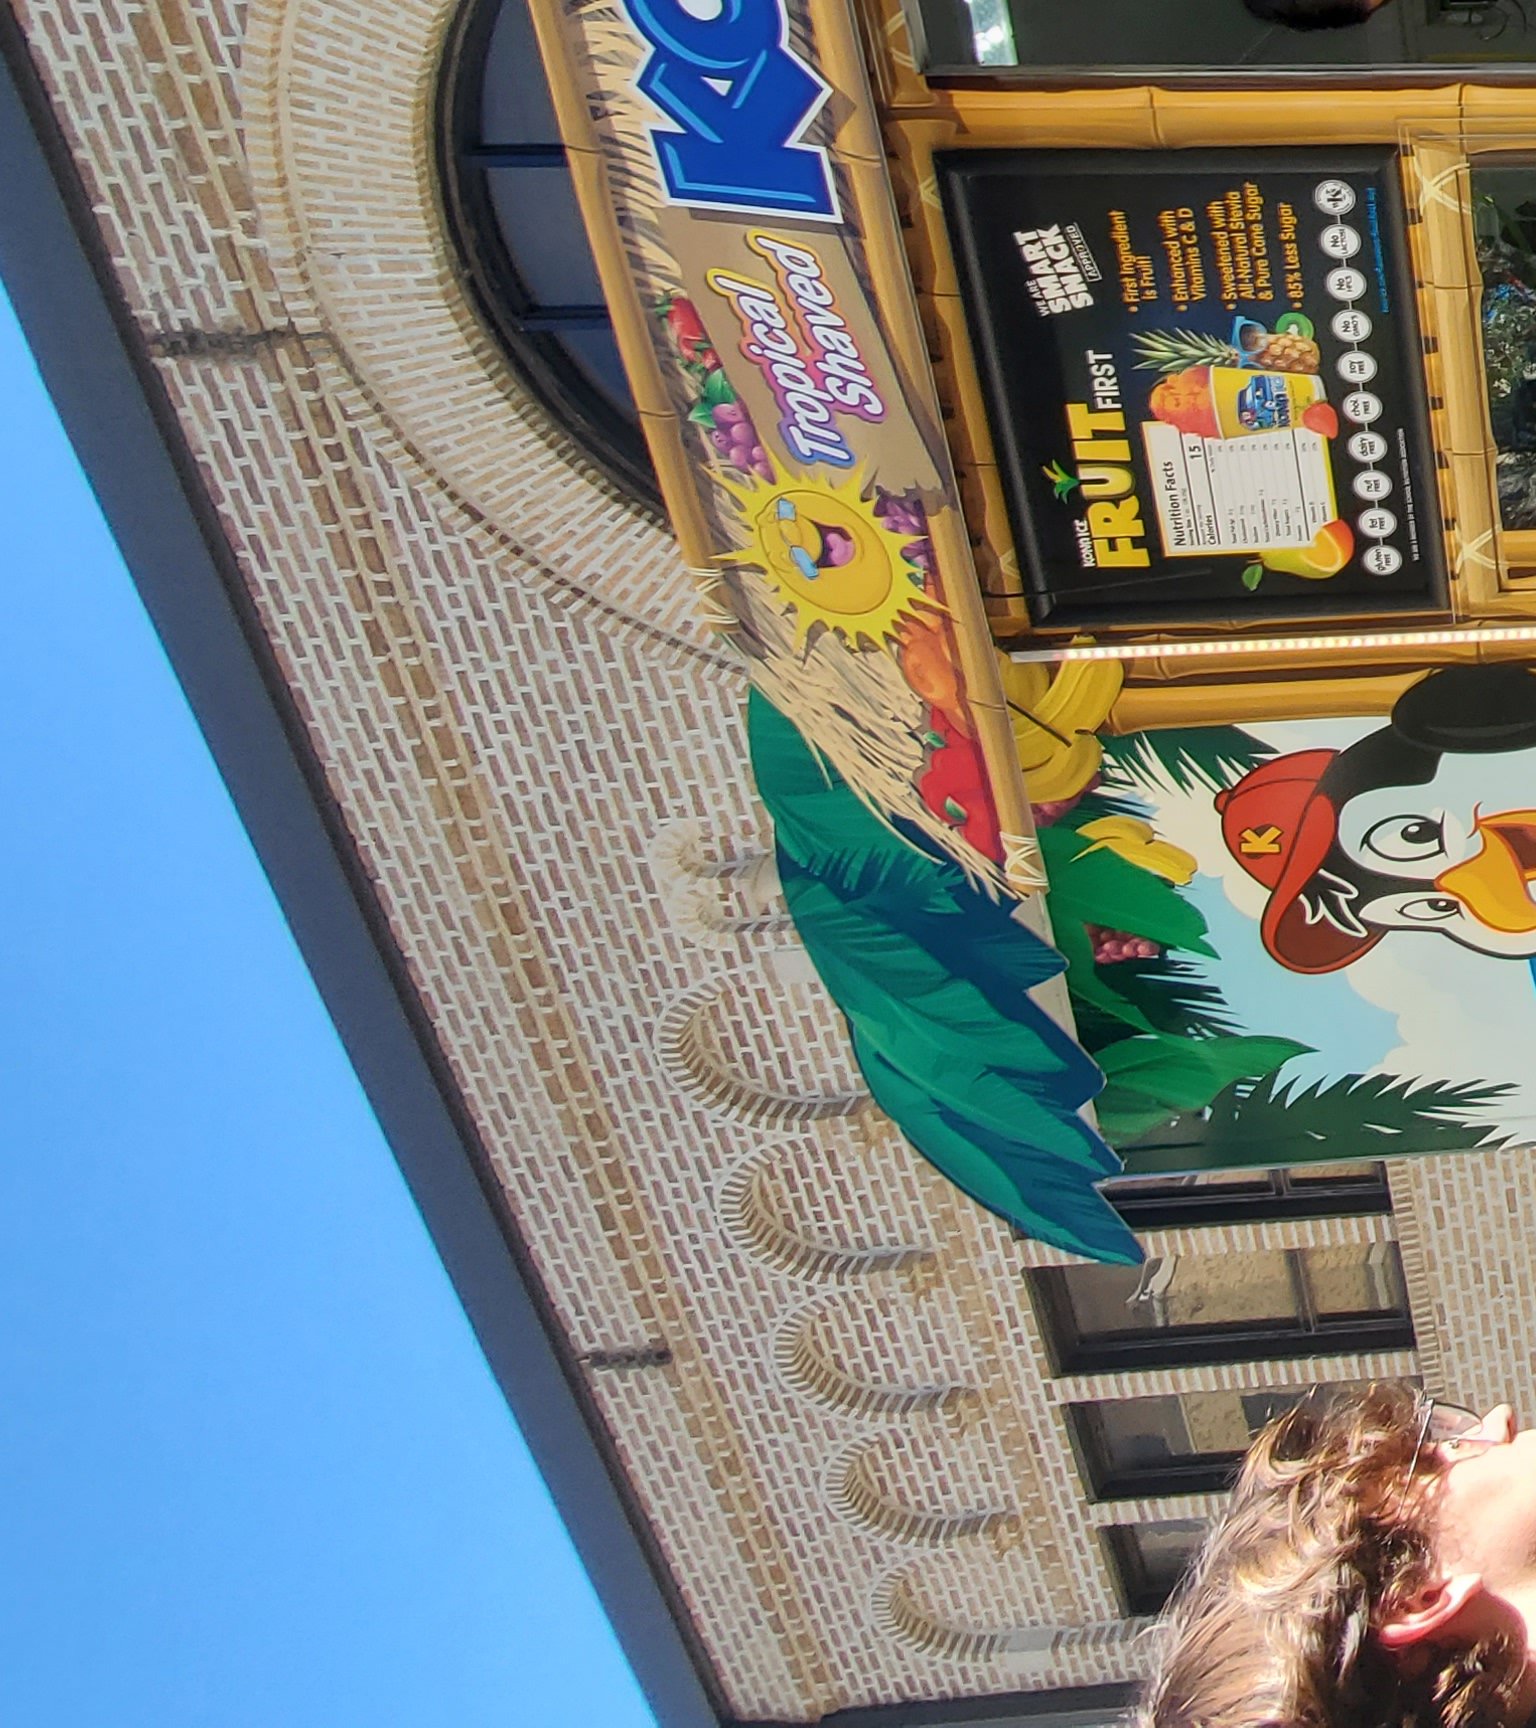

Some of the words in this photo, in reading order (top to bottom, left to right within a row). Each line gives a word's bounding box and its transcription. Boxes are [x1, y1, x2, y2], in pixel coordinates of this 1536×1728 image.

[1177, 208, 1193, 218] D
[1207, 201, 1226, 228] with
[1225, 191, 1244, 229] Stevia
[1243, 182, 1264, 220] Sugar
[1158, 211, 1177, 238] with
[1180, 221, 1195, 231] &
[1278, 203, 1297, 240] Sugar
[1066, 224, 1099, 278] APPROVED
[1108, 210, 1136, 274] Ingredient
[1182, 235, 1197, 244] C
[1249, 224, 1266, 256] Cane
[1329, 235, 1339, 247] No
[1338, 228, 1349, 254] LACTOSE
[1037, 224, 1094, 308] SNACK
[1210, 231, 1238, 300] Sweetened
[1231, 232, 1255, 299] All-Natural
[1284, 243, 1300, 268] Less
[1013, 230, 1072, 313] SMART
[1136, 256, 1155, 287] Fruit!
[1162, 241, 1188, 301] Enhanced
[1184, 248, 1206, 301] Vitamins
[1256, 259, 1272, 287] Pure
[1285, 272, 1304, 298] 85%
[1335, 278, 1345, 291] No
[1026, 279, 1044, 299] ARE
[1122, 277, 1140, 302] First
[1257, 291, 1274, 300] &
[1037, 300, 1051, 317] WE
[755, 235, 885, 417] Shaved
[1341, 321, 1351, 332] No
[712, 274, 851, 461] Tropical
[1086, 349, 1122, 409] FIRST
[1349, 361, 1359, 374] soy
[1189, 445, 1202, 459] 15
[1357, 436, 1370, 456] dairy
[1065, 403, 1151, 567] FRUIT
[1162, 461, 1179, 491] Facts
[1363, 480, 1374, 492] nut
[1074, 519, 1090, 537] ICE
[1166, 494, 1187, 546] Nutrition
[1205, 515, 1217, 545] Calories
[1368, 518, 1379, 528] fat
[1078, 537, 1096, 567] KONA
[1373, 548, 1387, 571] gluten
[1240, 823, 1287, 854] K
